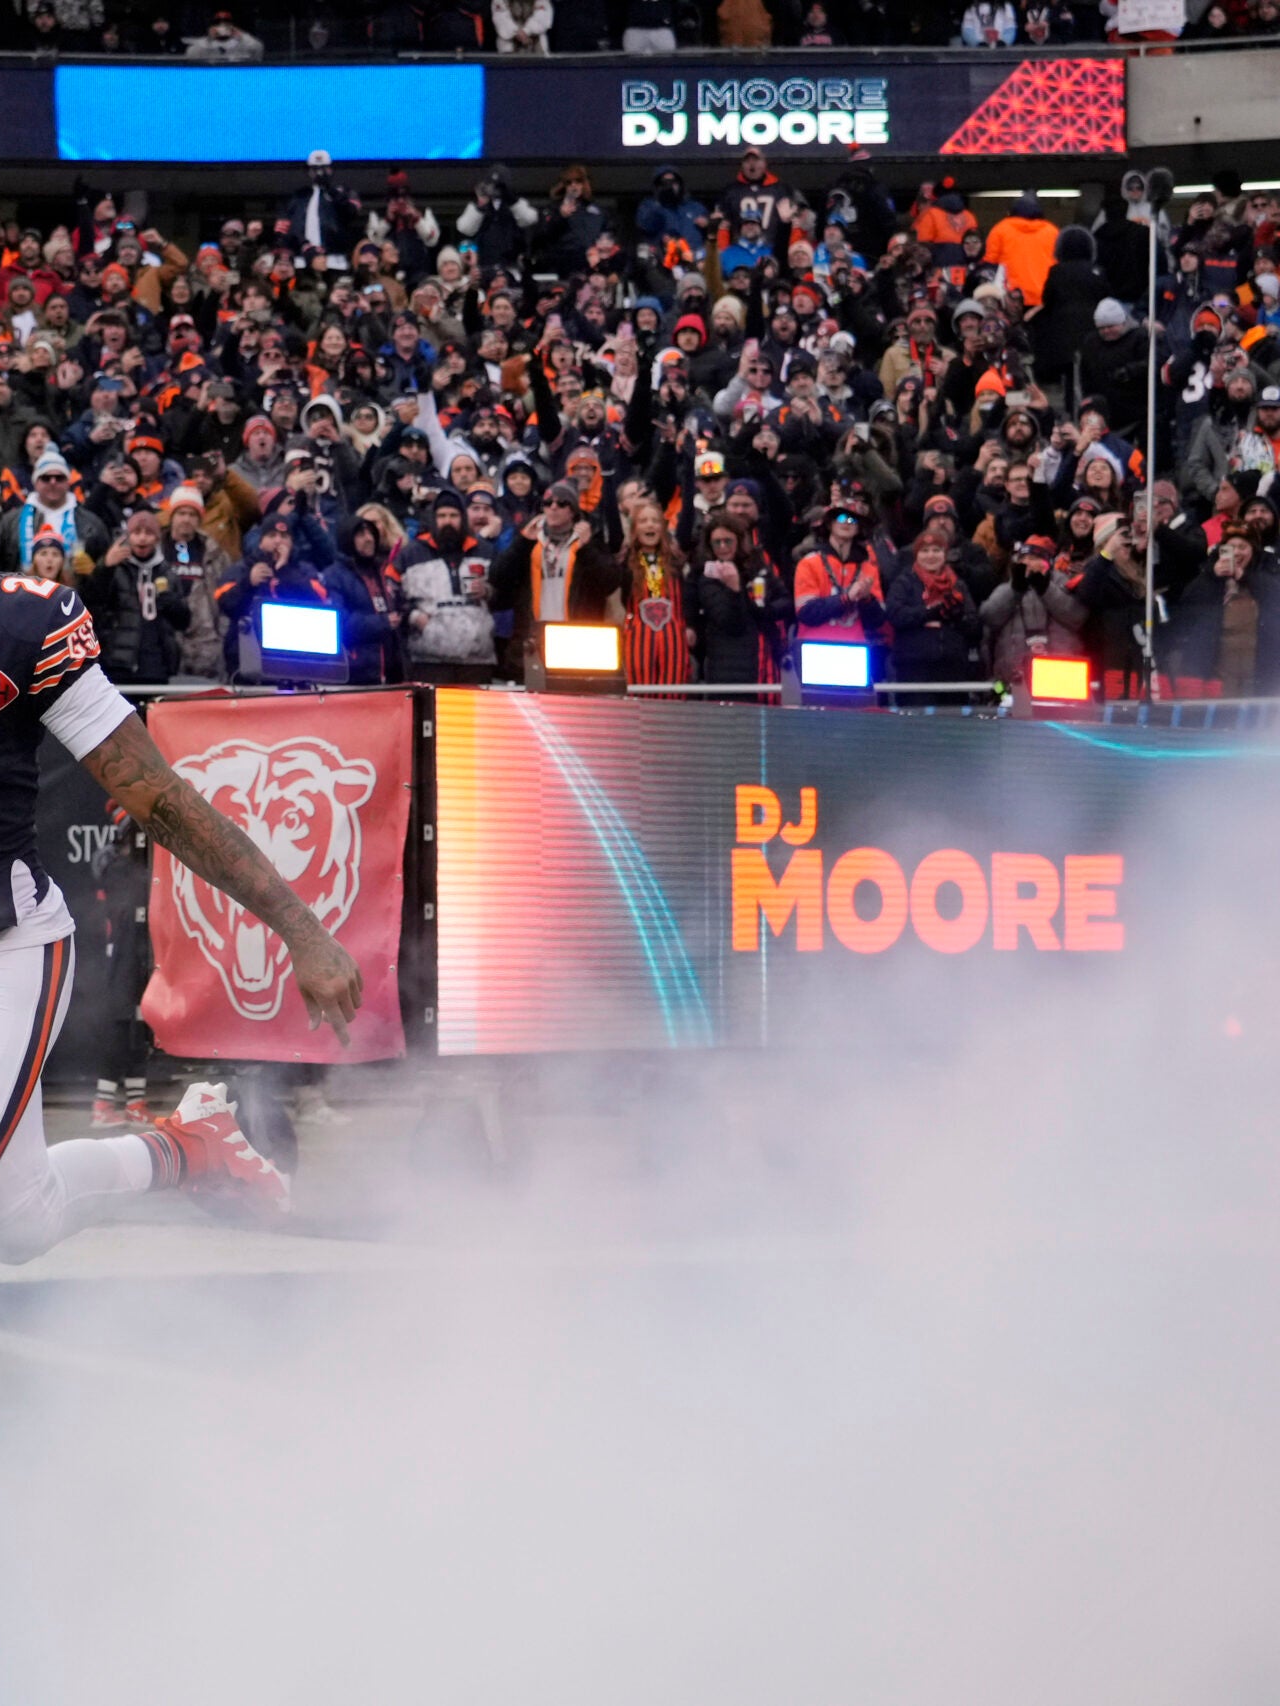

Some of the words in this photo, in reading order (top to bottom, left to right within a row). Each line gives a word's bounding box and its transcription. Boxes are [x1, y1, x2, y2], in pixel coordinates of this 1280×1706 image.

[621, 80, 687, 112] DJ
[697, 78, 888, 111] MOORE
[622, 112, 687, 146] DJ
[697, 111, 889, 145] MOORE
[735, 784, 818, 845] DJ
[731, 846, 1125, 954] MOORE
